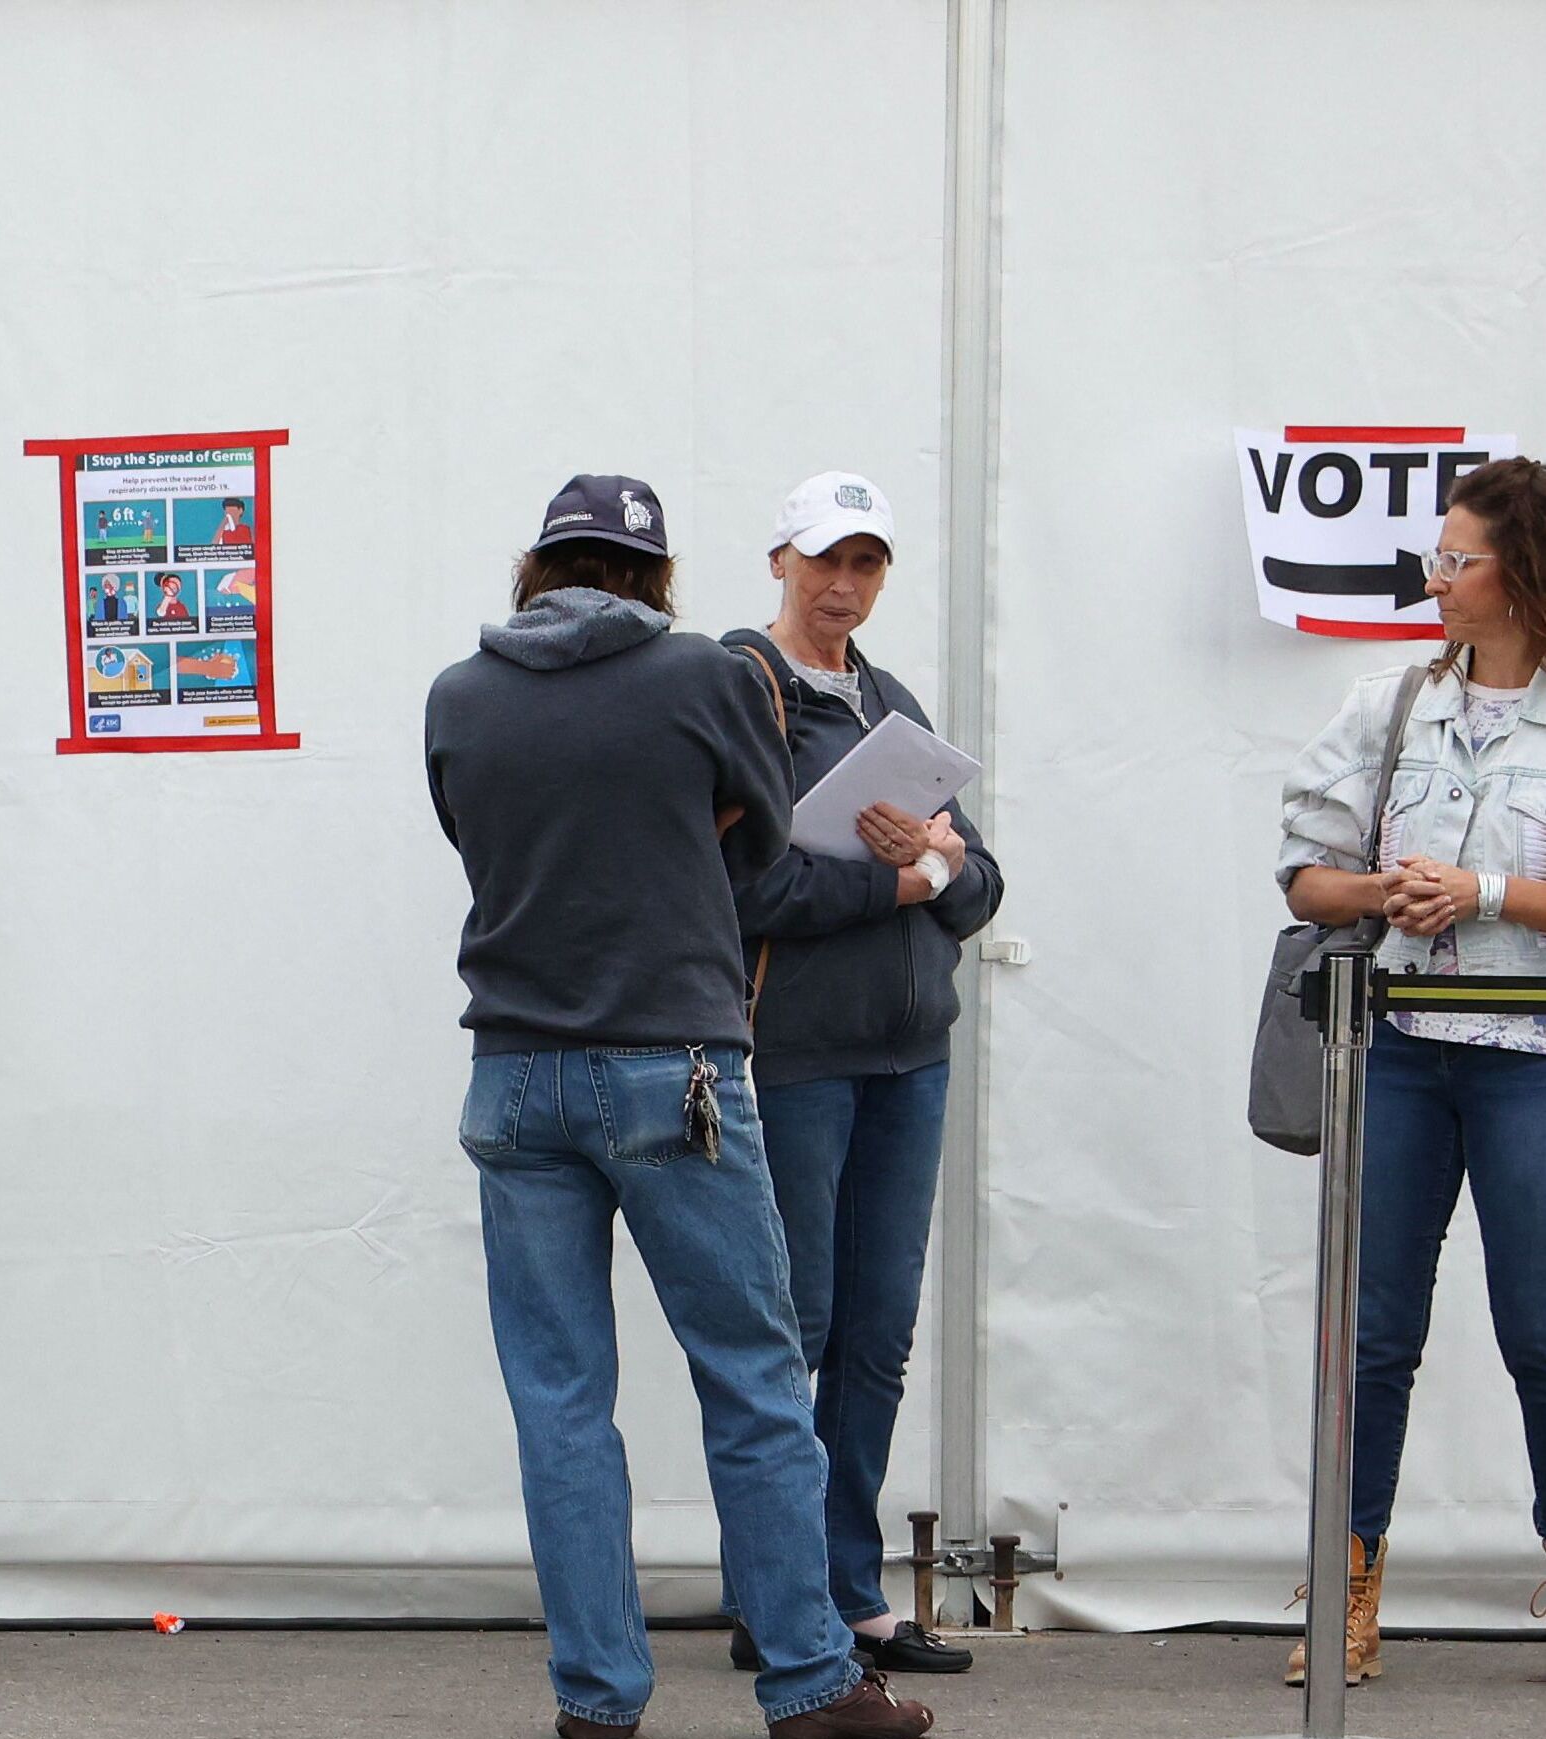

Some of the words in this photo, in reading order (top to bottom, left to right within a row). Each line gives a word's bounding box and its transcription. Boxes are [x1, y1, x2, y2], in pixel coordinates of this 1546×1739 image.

[92, 455, 121, 468] Stop
[125, 453, 145, 465] the
[147, 452, 192, 467] Spread
[196, 451, 209, 462] of
[212, 450, 254, 462] Germs
[122, 477, 139, 485] Help
[141, 477, 168, 485] prevent
[183, 475, 206, 483] spread
[208, 474, 216, 482] of
[149, 485, 178, 493] diseases
[113, 508, 121, 521] 6
[123, 507, 134, 520] ft
